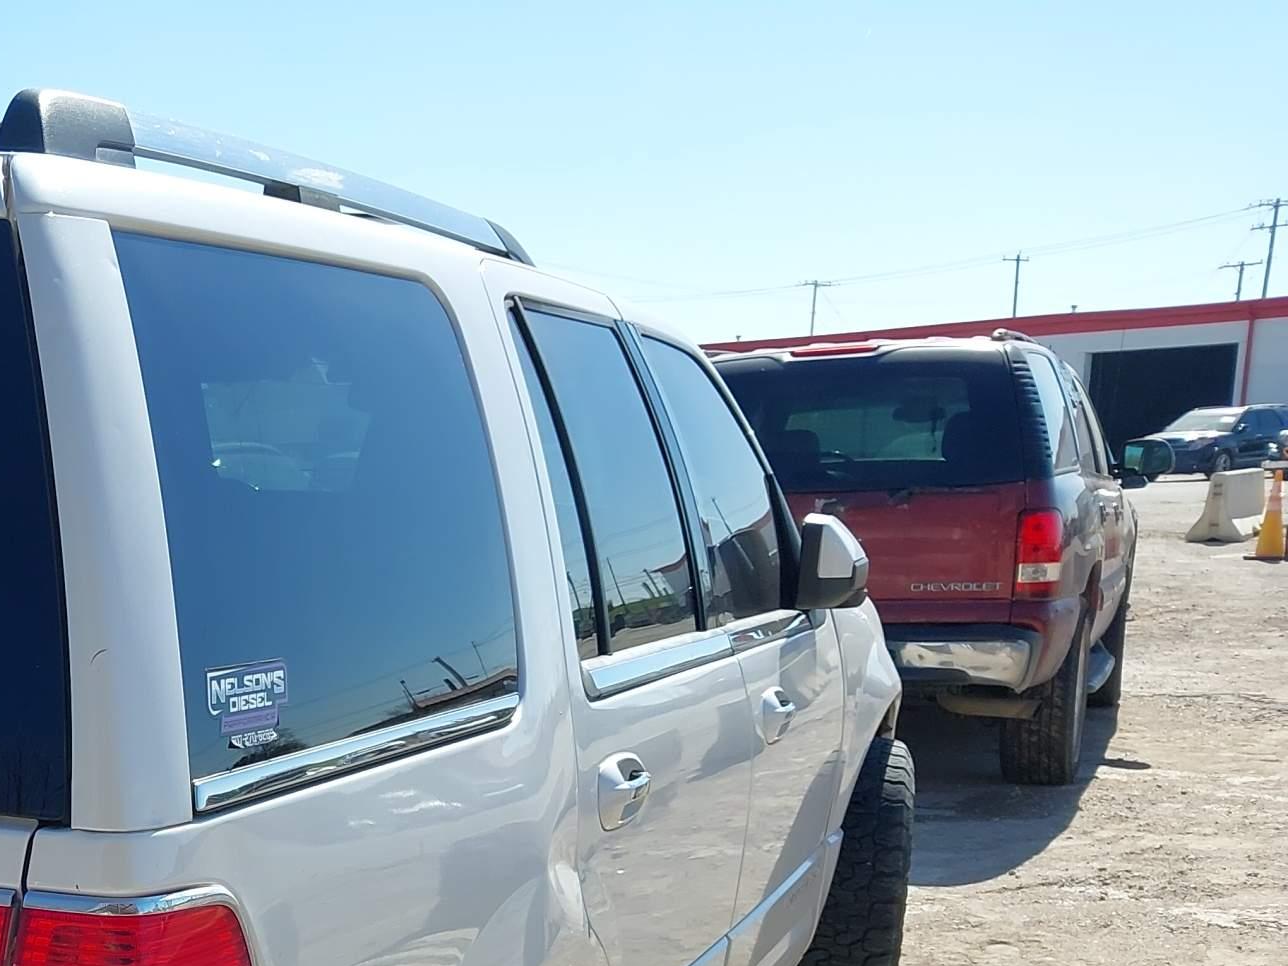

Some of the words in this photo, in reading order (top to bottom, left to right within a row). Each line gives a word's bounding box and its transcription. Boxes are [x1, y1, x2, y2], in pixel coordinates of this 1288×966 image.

[910, 581, 1003, 592] CHEVROLET
[211, 670, 284, 705] NELSON'S
[229, 692, 273, 713] DIESEL
